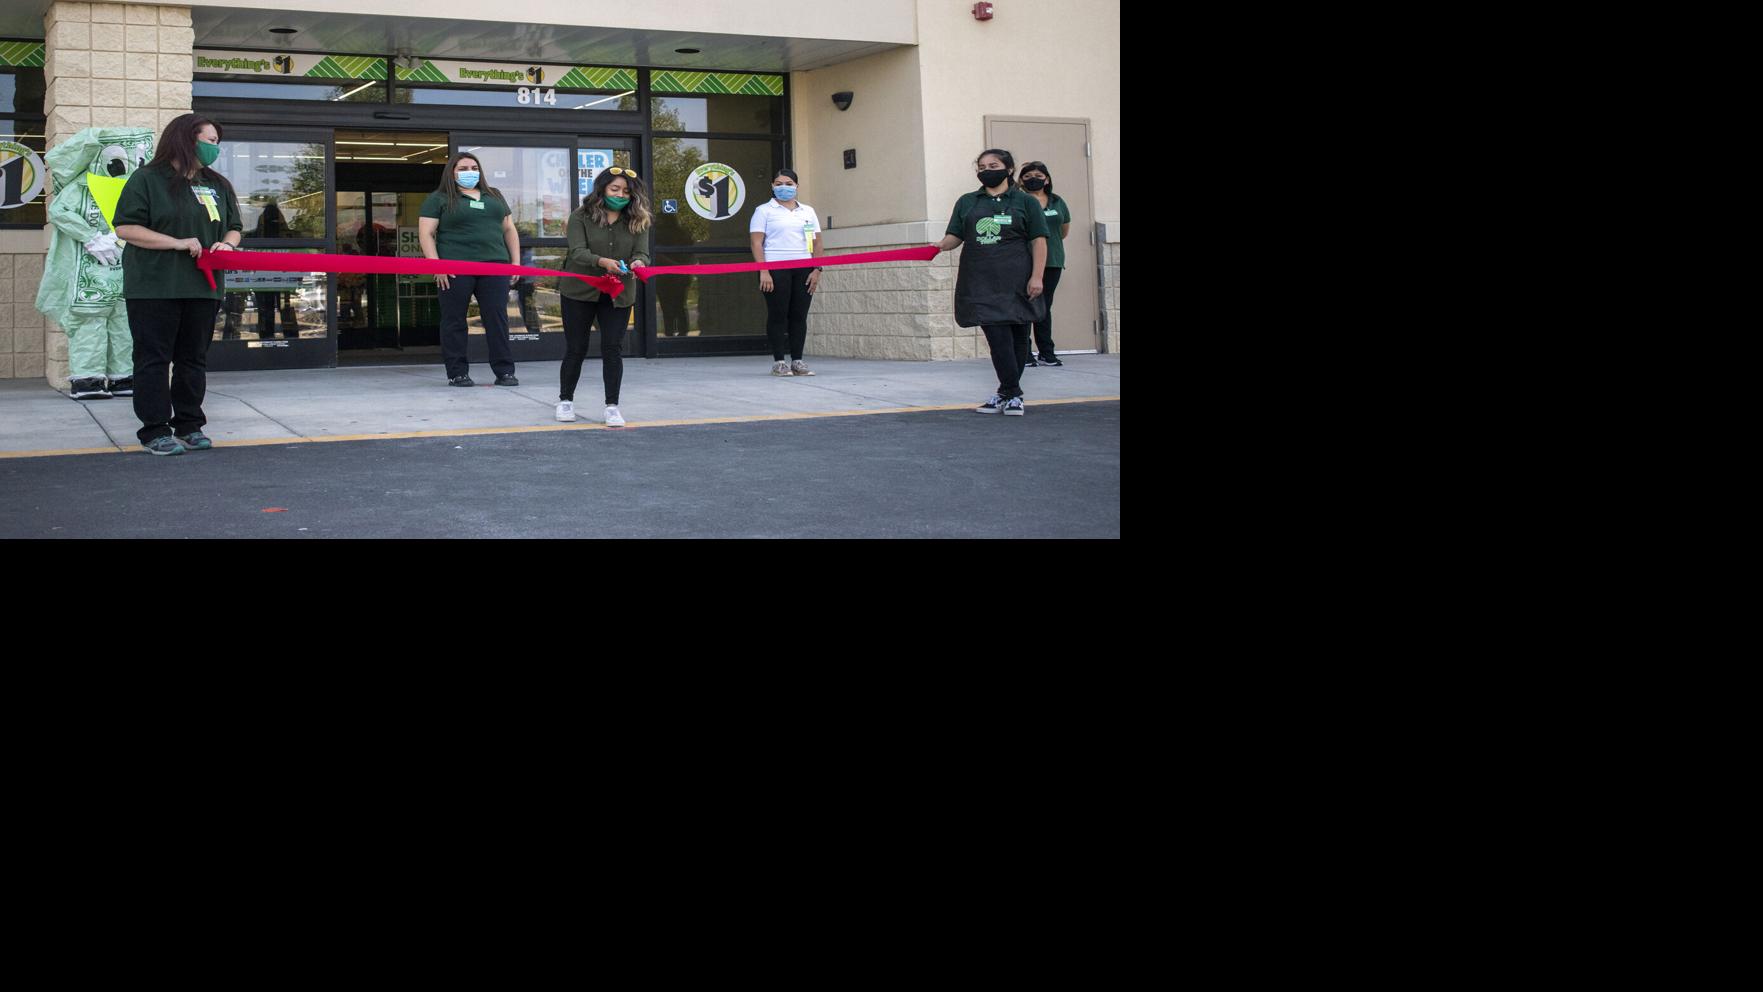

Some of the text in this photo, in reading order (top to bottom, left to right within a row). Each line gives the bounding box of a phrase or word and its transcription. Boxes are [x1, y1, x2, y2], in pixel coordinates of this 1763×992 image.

[197, 56, 270, 72] Everything's
[459, 67, 525, 83] Everything's
[517, 86, 557, 106] 814
[0, 156, 25, 208] 1
[698, 175, 731, 218] $1
[401, 231, 420, 243] SH
[401, 243, 421, 253] ON
